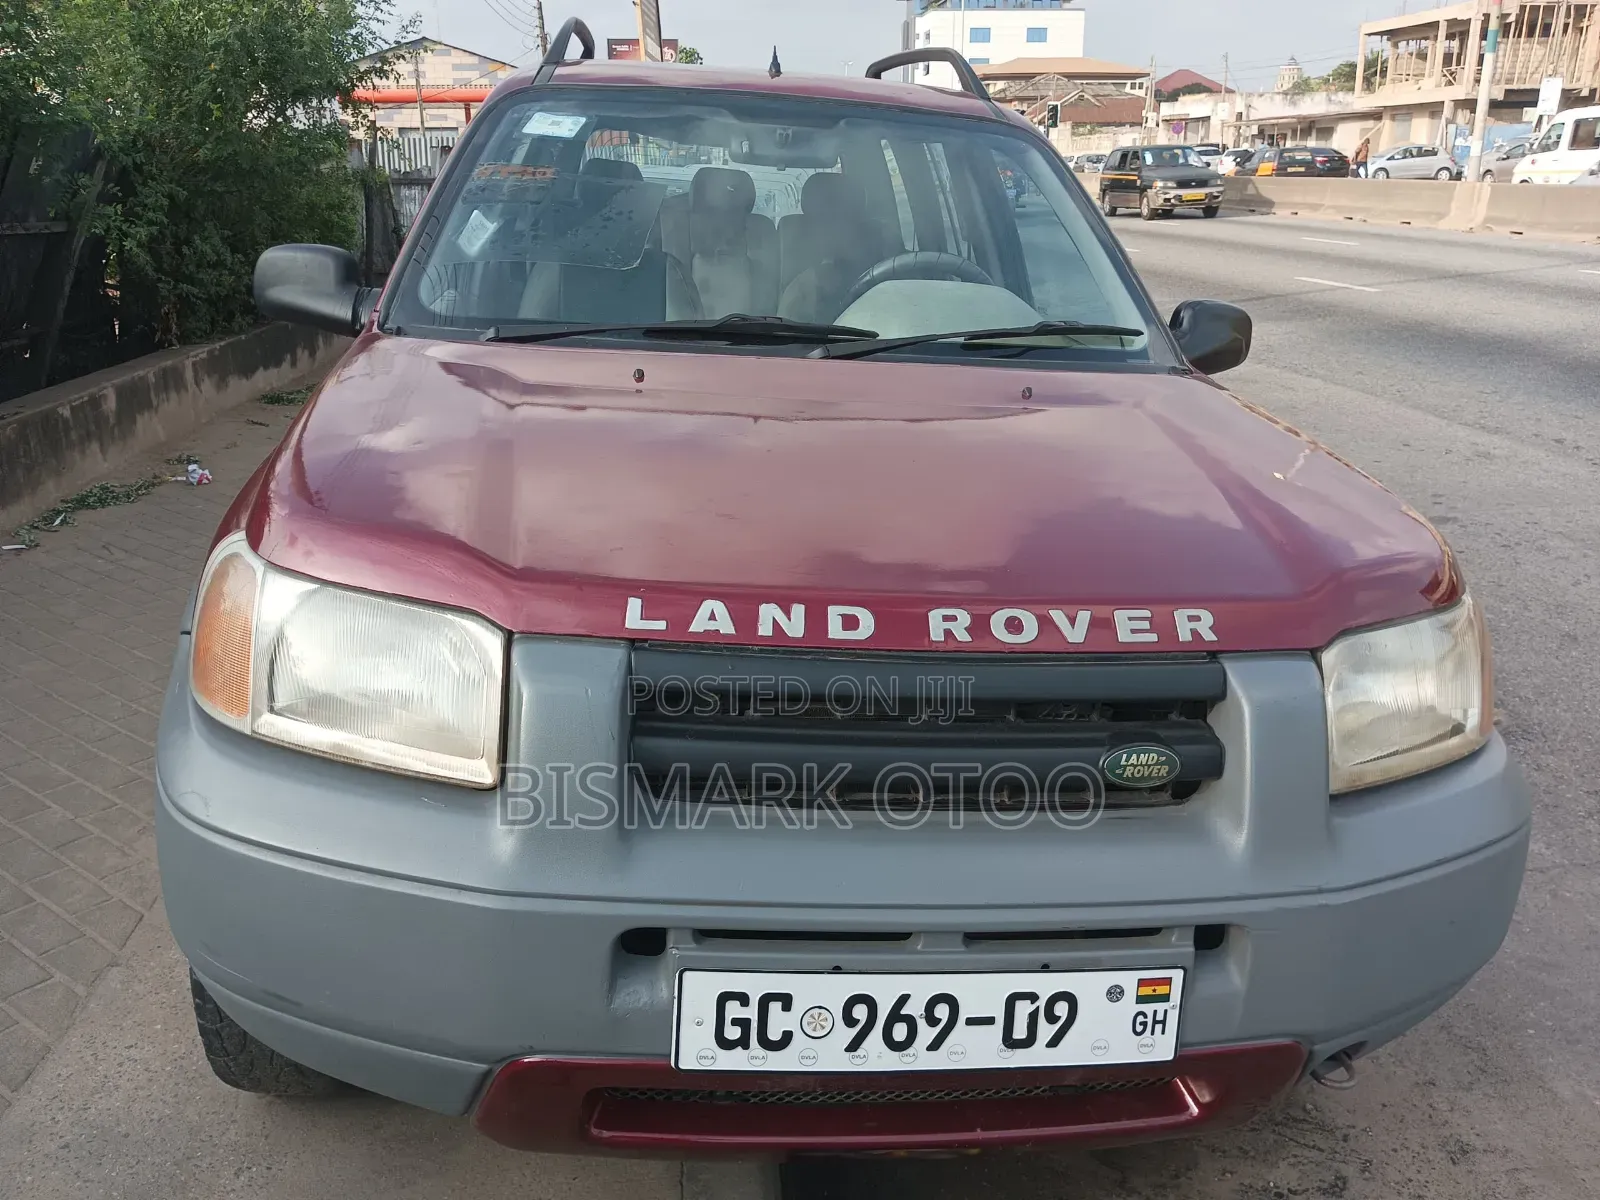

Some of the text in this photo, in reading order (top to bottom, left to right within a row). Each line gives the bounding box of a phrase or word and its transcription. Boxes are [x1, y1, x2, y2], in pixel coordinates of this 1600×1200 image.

[624, 596, 1219, 644] LAND ROVER
[1120, 753, 1158, 765] LAND
[1122, 766, 1169, 778] ROVER
[714, 990, 1079, 1053] GC 969-09
[1131, 1009, 1168, 1037] GH
